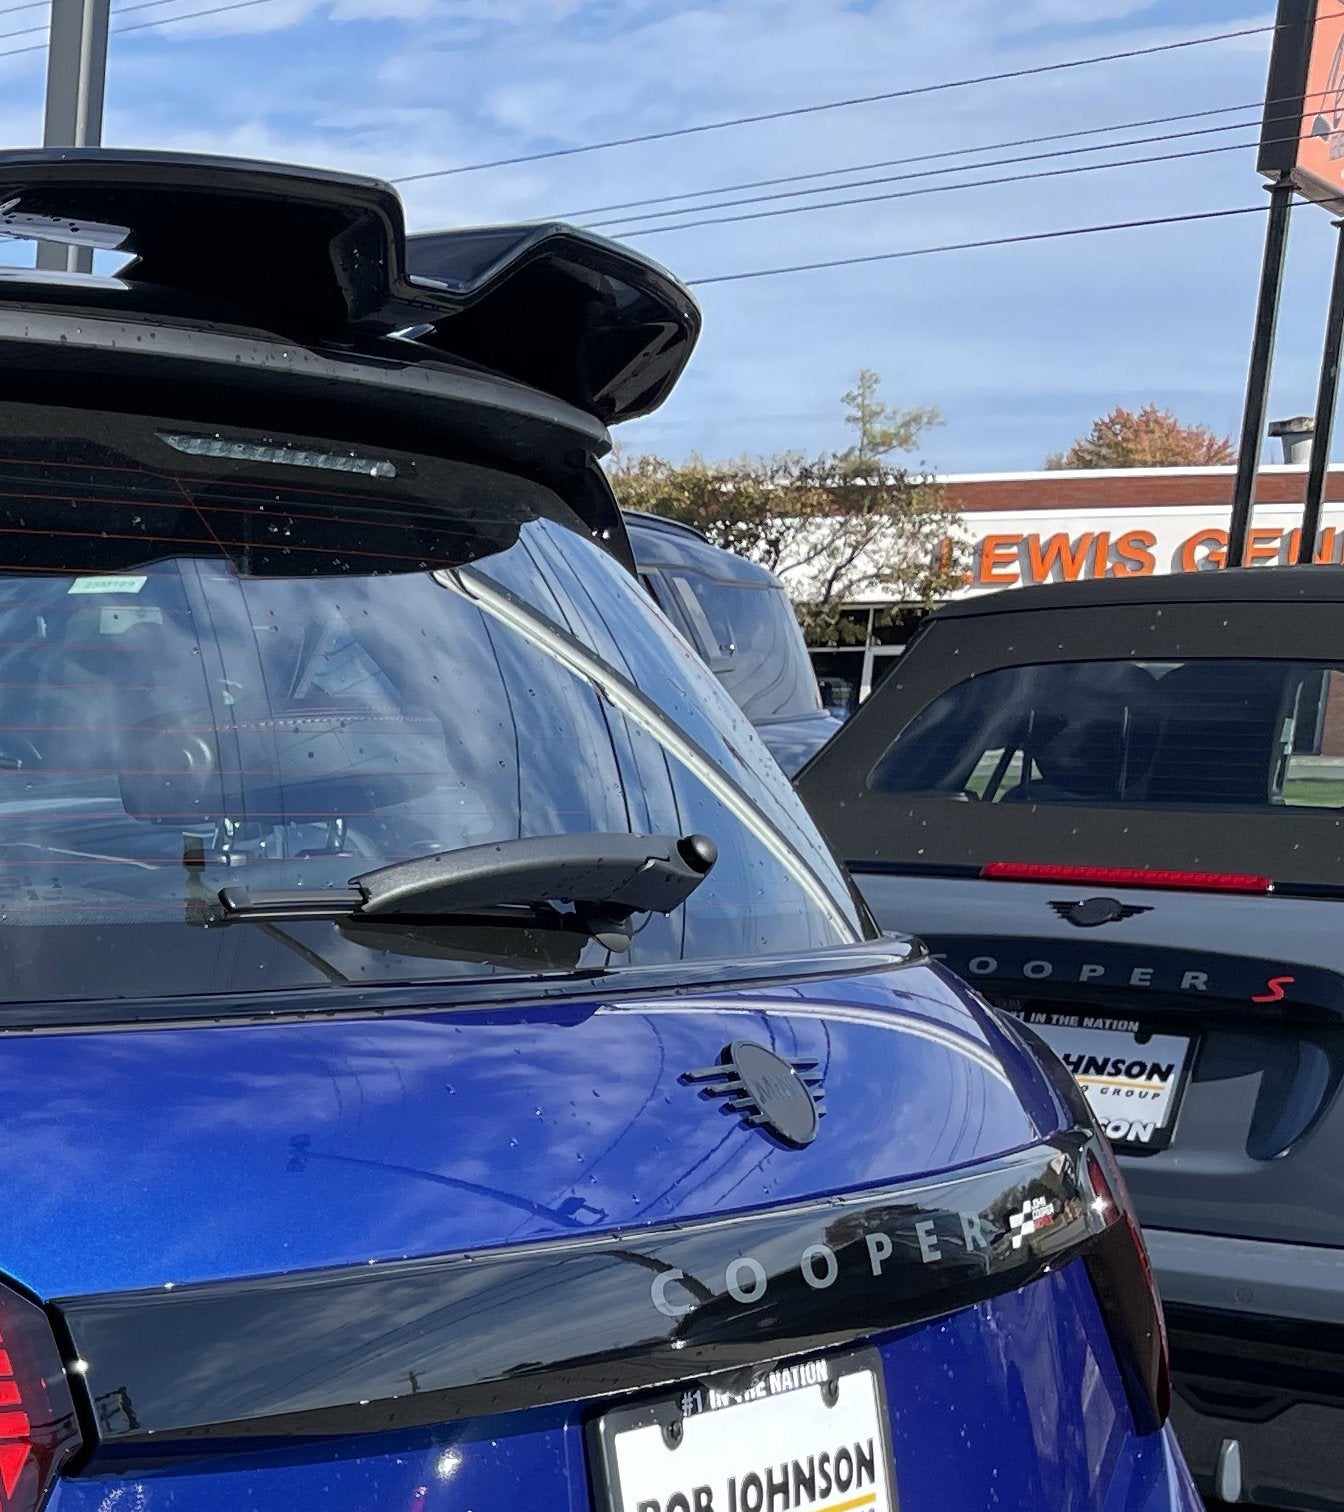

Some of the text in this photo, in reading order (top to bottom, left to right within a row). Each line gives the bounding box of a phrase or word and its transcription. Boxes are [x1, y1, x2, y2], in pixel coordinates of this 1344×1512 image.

[930, 953, 1295, 1003] OOPER S
[1030, 1012, 1047, 1024] IN
[1050, 1013, 1080, 1027] THE
[1082, 1017, 1141, 1033] NATION
[1062, 1053, 1175, 1083] HNSON
[1099, 1086, 1161, 1101] GROUP
[650, 1210, 988, 1318] COOPER
[681, 1389, 704, 1417] #1
[769, 1358, 829, 1395] NATION
